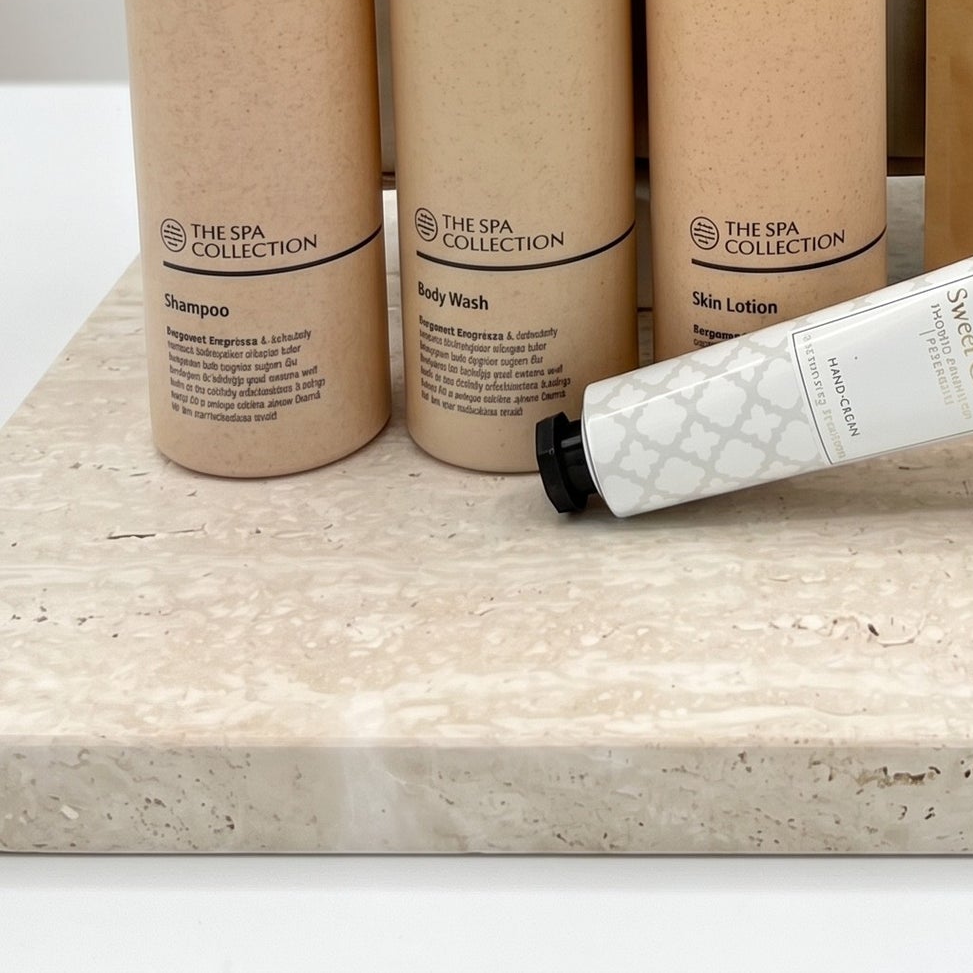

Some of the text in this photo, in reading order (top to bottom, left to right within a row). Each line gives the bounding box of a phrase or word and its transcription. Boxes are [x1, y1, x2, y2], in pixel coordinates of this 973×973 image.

[190, 223, 265, 241] THE SPA
[442, 214, 513, 234] THE SPA
[725, 220, 799, 237] THE SPA
[191, 234, 317, 259] COLLECTION
[442, 231, 564, 252] COLLECTION
[725, 229, 845, 255] COLLECTION
[164, 293, 229, 318] Shampoo
[418, 281, 489, 310] Body Wash
[692, 291, 778, 314] Skin Lotion
